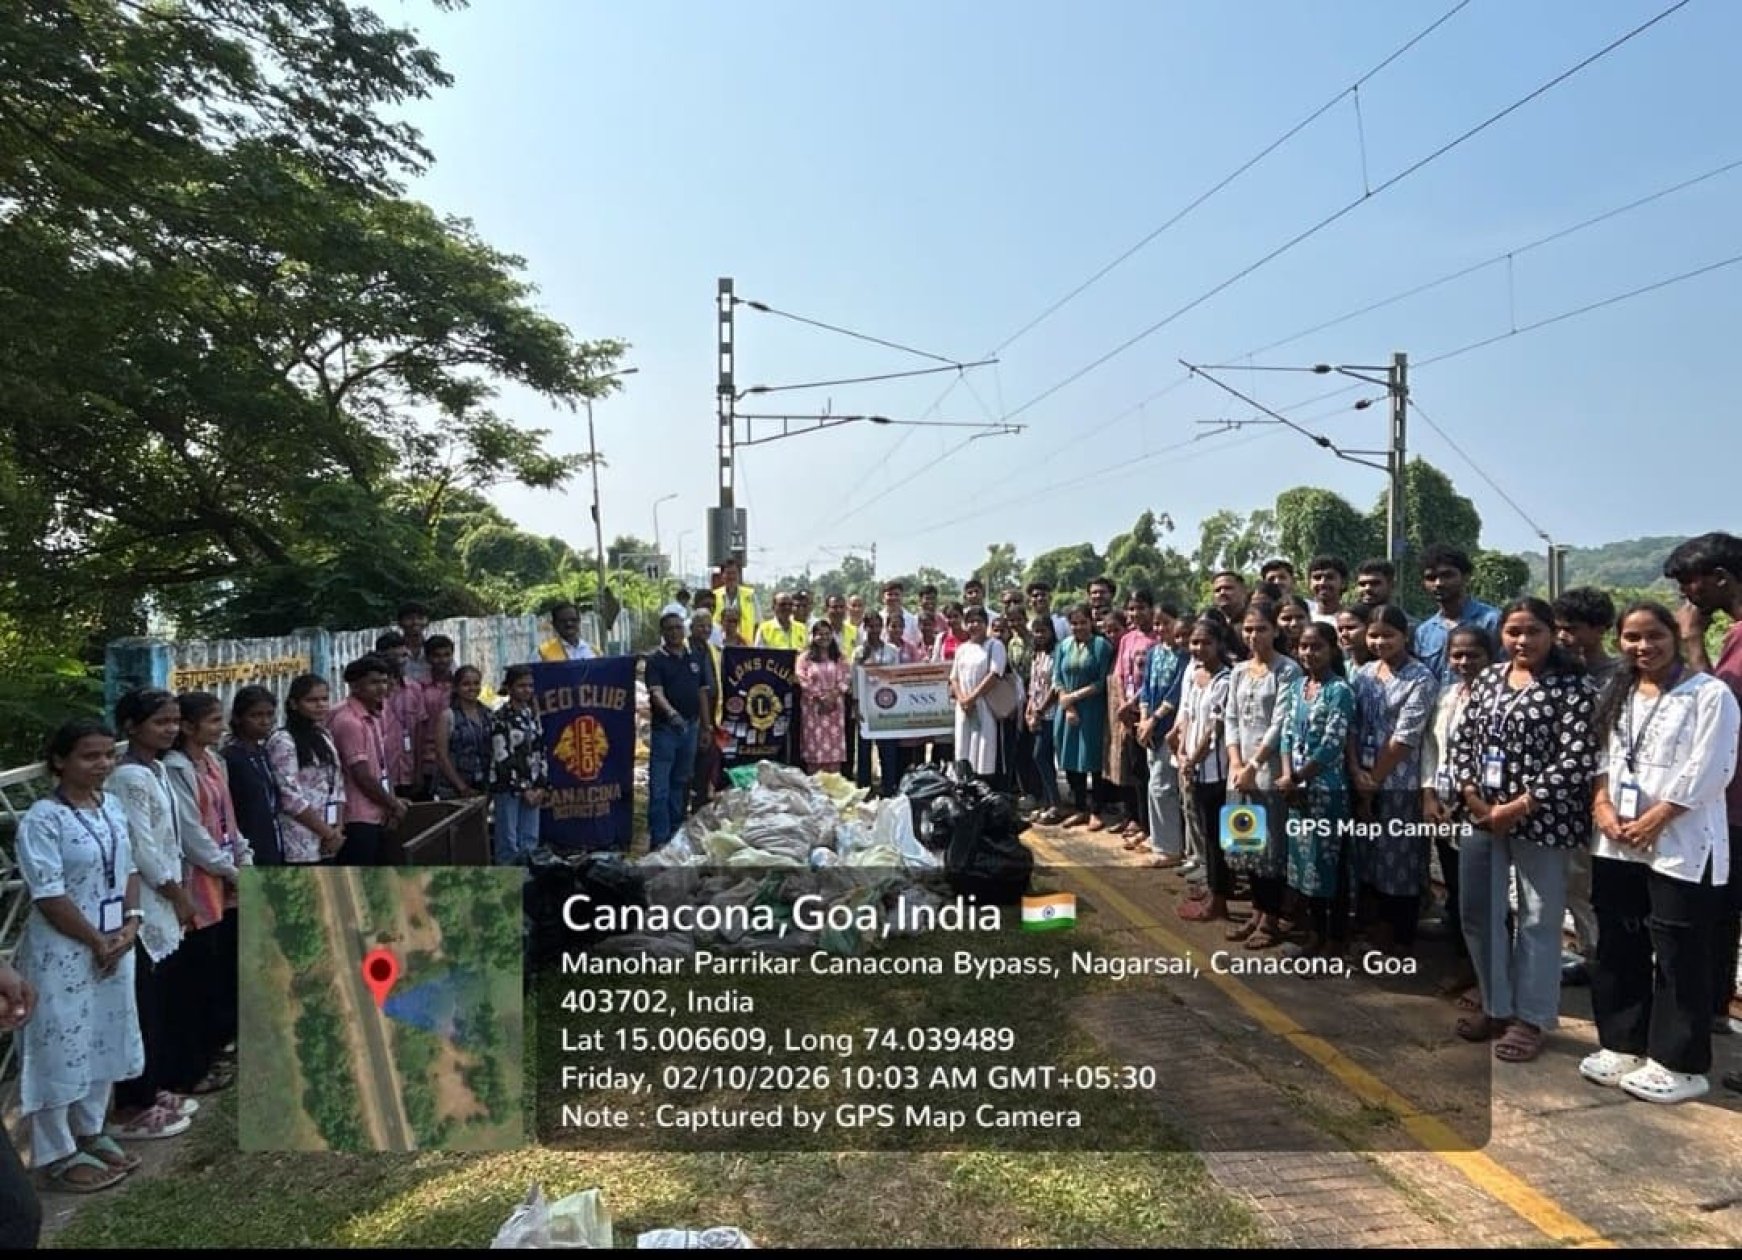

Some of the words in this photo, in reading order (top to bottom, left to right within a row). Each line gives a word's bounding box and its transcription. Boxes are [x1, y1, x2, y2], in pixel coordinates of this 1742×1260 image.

[537, 686, 574, 716] LEO
[578, 683, 627, 711] CLUB
[580, 720, 594, 773] LEO
